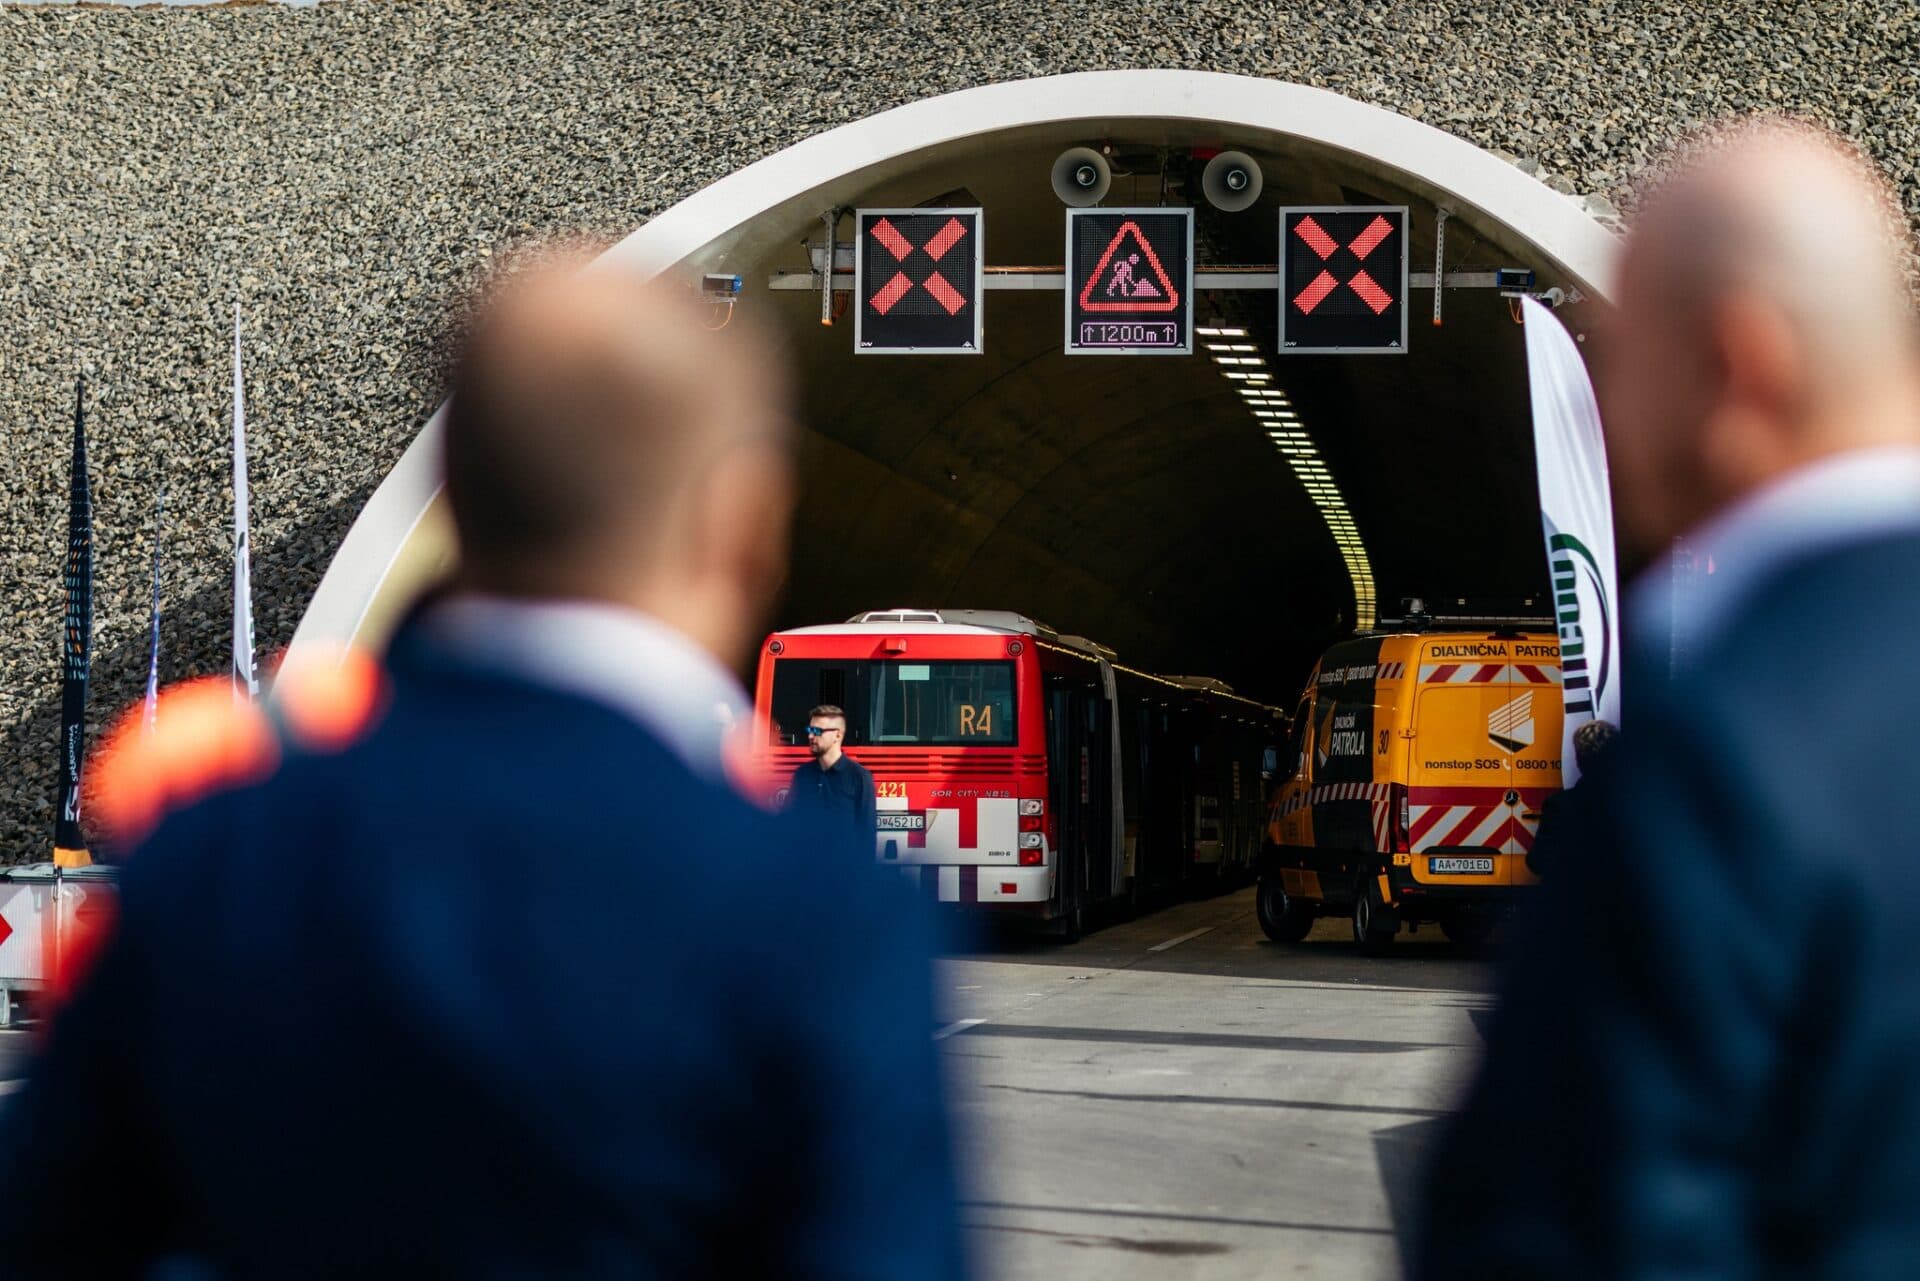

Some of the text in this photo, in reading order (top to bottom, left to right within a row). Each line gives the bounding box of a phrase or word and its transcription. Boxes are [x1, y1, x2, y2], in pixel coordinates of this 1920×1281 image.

[1100, 326, 1157, 341] 1200m
[1431, 643, 1507, 657] DIAĽNIČNÁ
[960, 704, 991, 736] R4
[1331, 731, 1365, 756] PATROLA
[1378, 729, 1389, 755] 30
[1425, 760, 1472, 771] nonstop
[1475, 760, 1500, 770] SOS
[1516, 760, 1547, 769] 0800
[878, 782, 906, 798] 421
[931, 789, 952, 798] SOR
[957, 789, 979, 798] CITY
